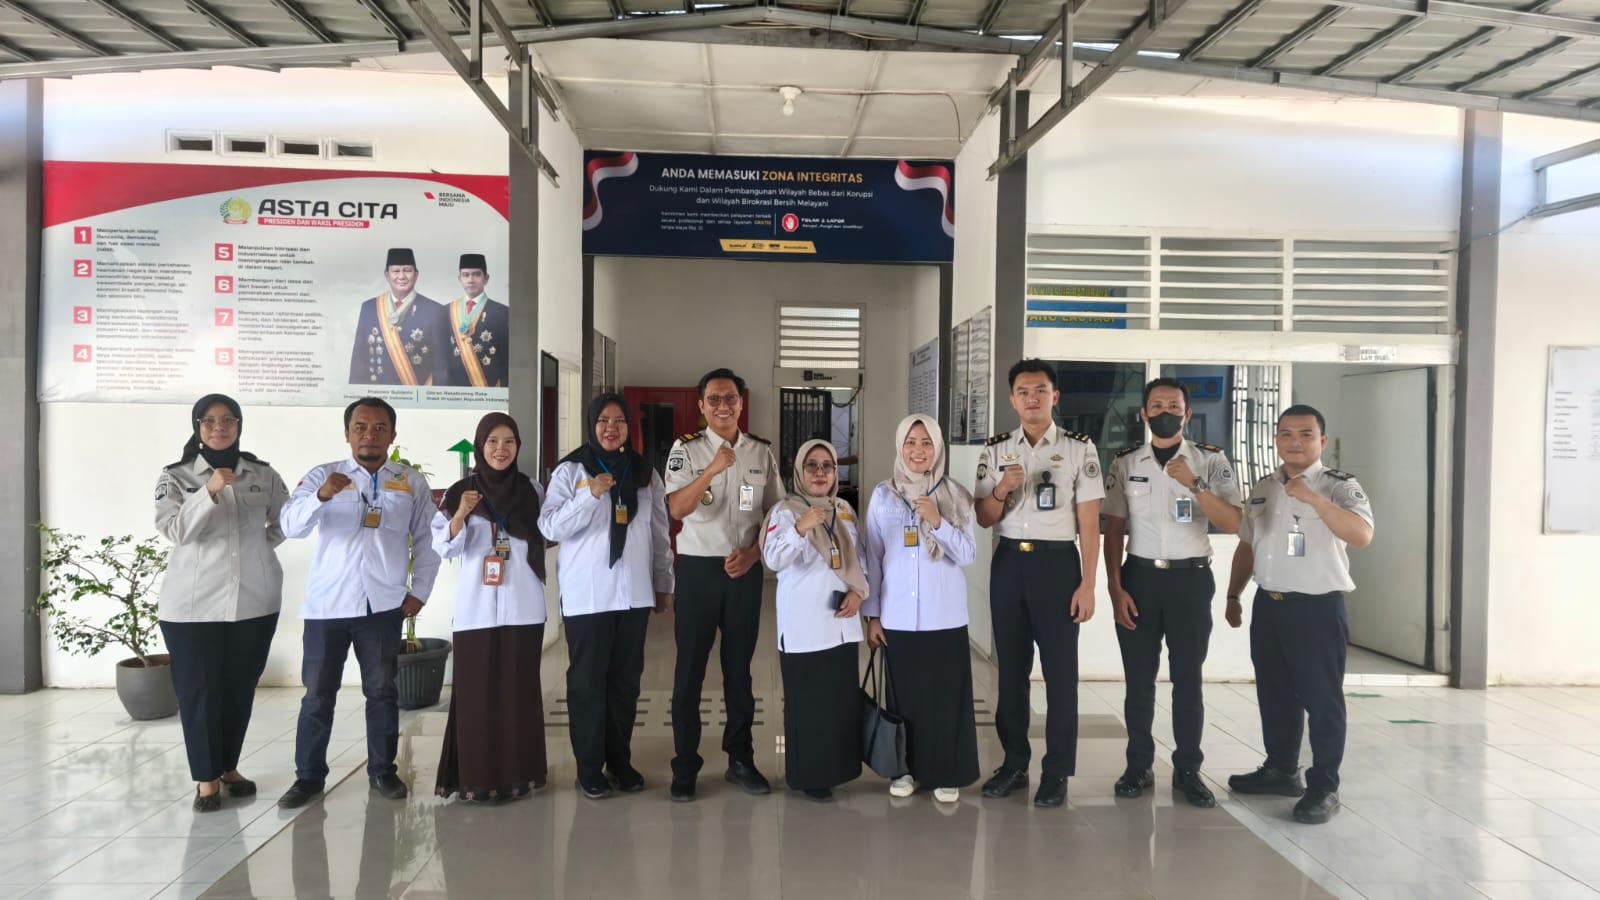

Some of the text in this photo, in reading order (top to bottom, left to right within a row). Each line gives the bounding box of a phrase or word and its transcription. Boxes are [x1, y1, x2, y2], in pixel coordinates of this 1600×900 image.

[662, 168, 864, 183] ANDA MEMASUKI ZONA INTEGRITAS
[650, 184, 678, 194] Dukung
[724, 187, 776, 196] Pembangunan
[778, 188, 806, 196] Wilayah
[258, 199, 398, 219] ASTA CITA
[80, 230, 86, 242] 1
[218, 247, 230, 258] 5
[77, 263, 88, 274] 2
[218, 280, 230, 290] 6
[77, 310, 88, 322] 3
[218, 312, 230, 324] 7
[76, 348, 88, 359] 4
[218, 352, 230, 362] 8
